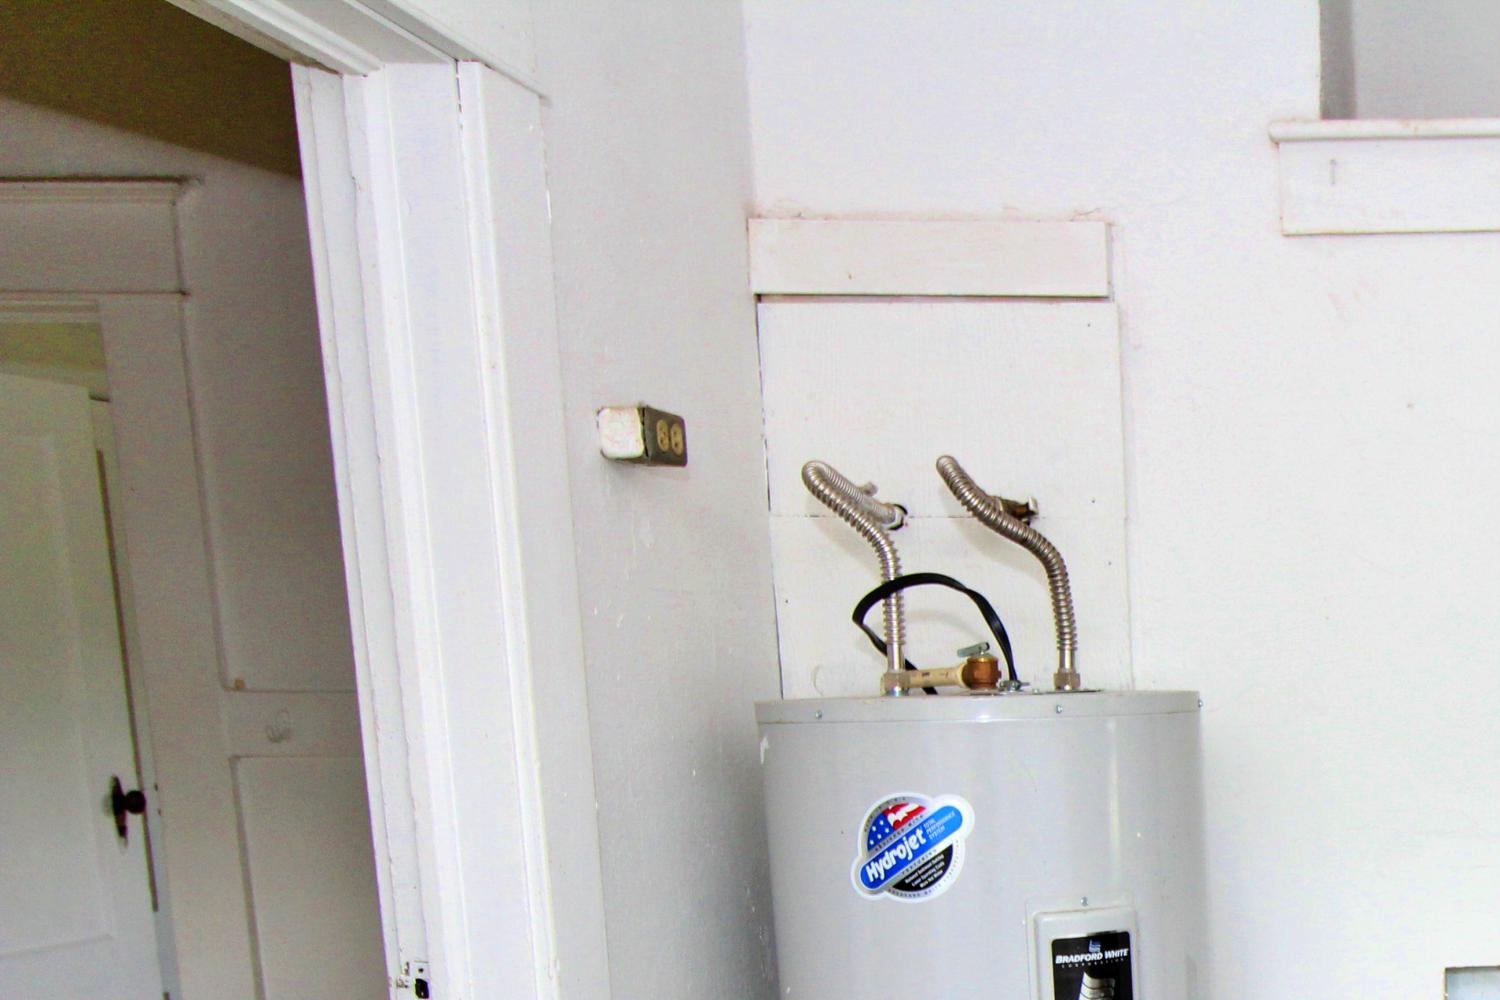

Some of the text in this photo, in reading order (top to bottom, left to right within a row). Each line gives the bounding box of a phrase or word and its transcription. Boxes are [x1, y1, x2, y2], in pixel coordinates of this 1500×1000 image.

[865, 827, 927, 883] Hydrojet
[1055, 948, 1129, 964] BRADFORD WHITE
